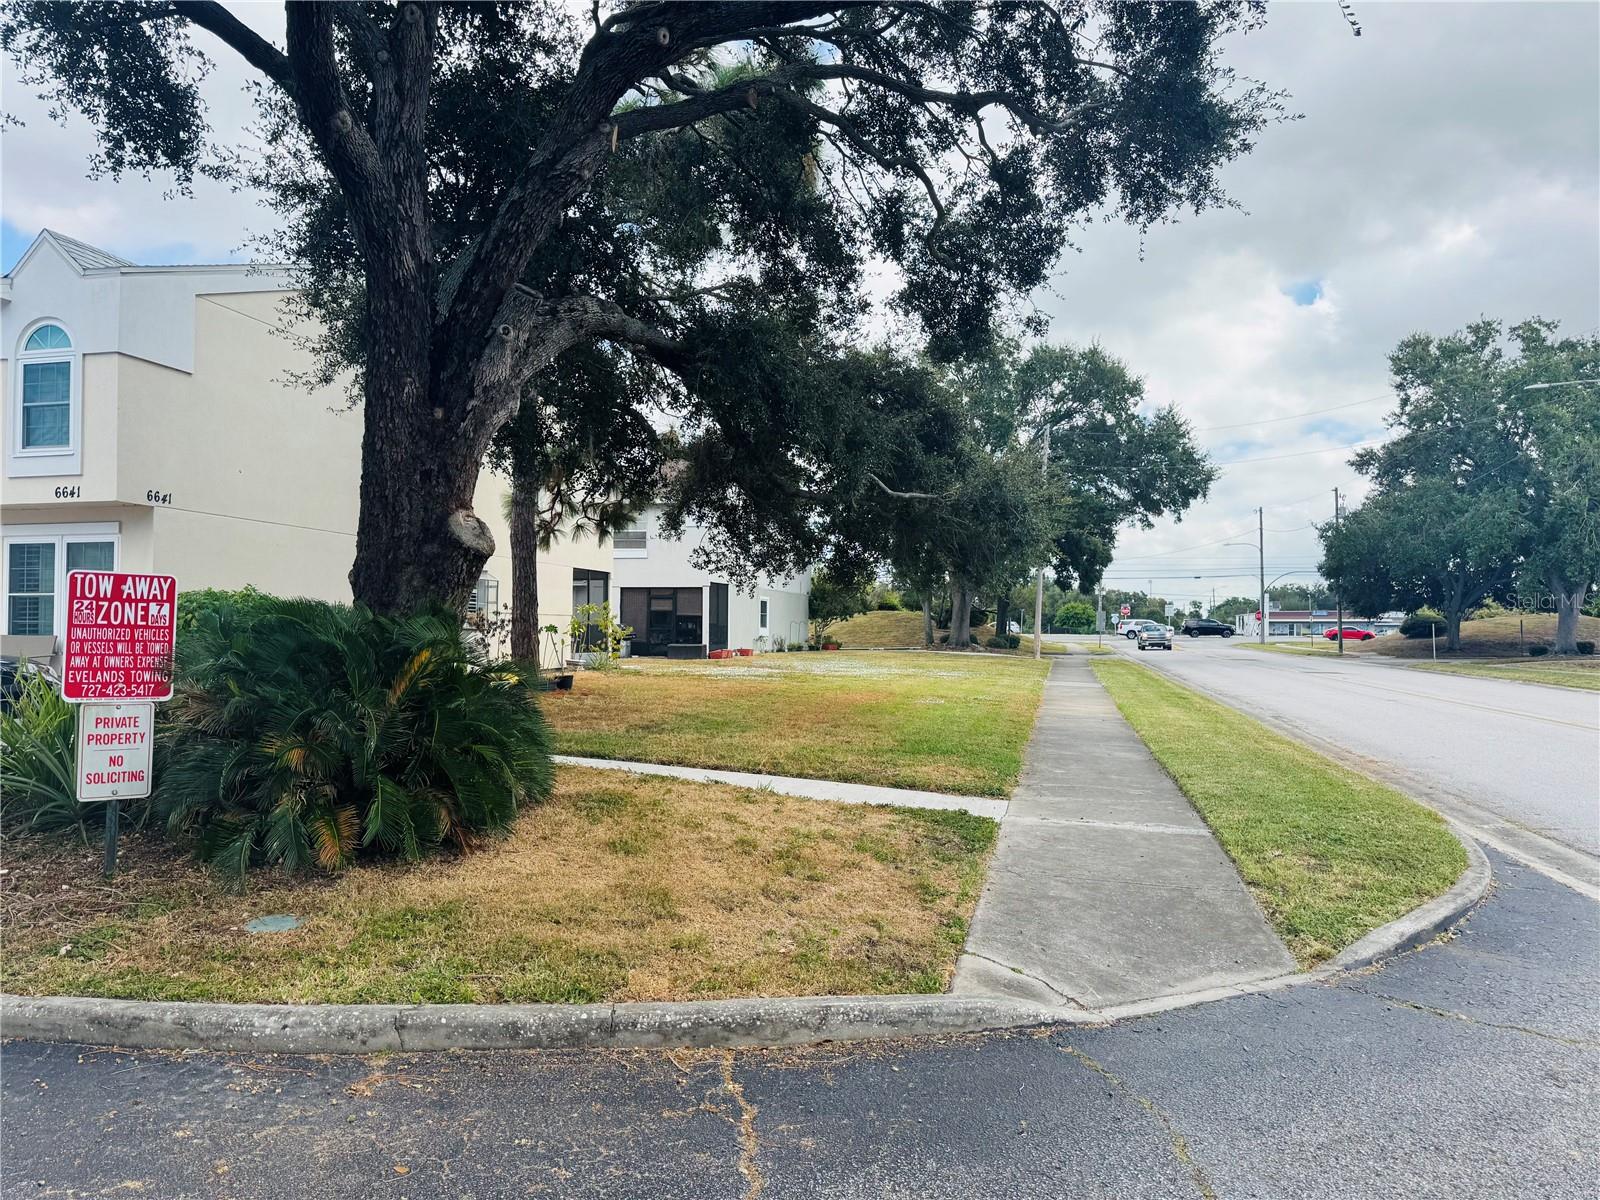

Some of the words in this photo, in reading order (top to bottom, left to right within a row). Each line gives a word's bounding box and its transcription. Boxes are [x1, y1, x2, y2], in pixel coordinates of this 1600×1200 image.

[55, 486, 80, 498] 6641
[147, 490, 171, 504] 6641
[74, 574, 114, 598] TOW
[123, 576, 172, 600] AWAY
[75, 601, 94, 611] 24
[156, 604, 164, 614] 7
[74, 612, 94, 624] HOURS
[97, 601, 146, 625] ZONE
[150, 614, 167, 625] DAYS
[71, 628, 130, 640] UNAUTHORIZED
[134, 629, 169, 641] VEHICLES
[70, 641, 80, 654] OR
[84, 642, 113, 654] VESSELS
[117, 642, 132, 654] WILL
[136, 643, 143, 654] BE
[147, 642, 169, 655] TOWED
[70, 656, 89, 668] AWAY
[92, 656, 101, 668] AT
[104, 656, 134, 668] OWNERS
[69, 671, 125, 683] EVELANDS
[131, 671, 168, 682] TOWING
[81, 684, 155, 697] 727-423-5417
[95, 716, 140, 729] PRIVATE
[87, 732, 145, 745] PROPERTY
[109, 755, 124, 767] NO
[86, 770, 145, 784] SOLICITING
